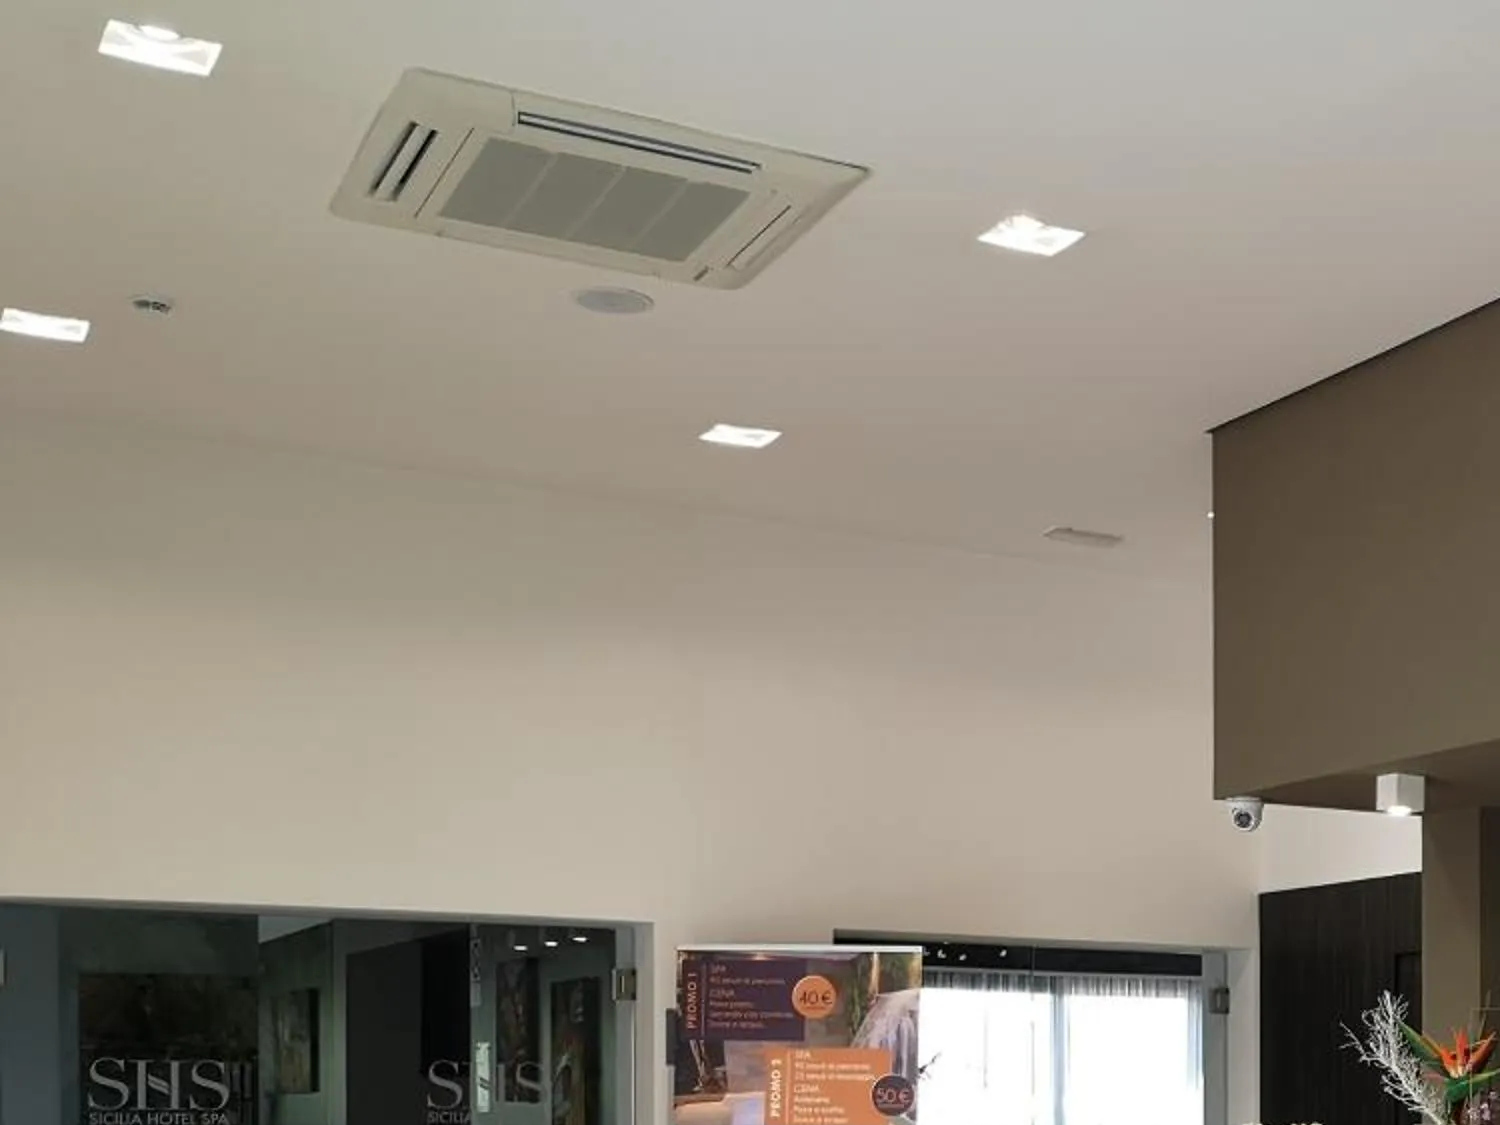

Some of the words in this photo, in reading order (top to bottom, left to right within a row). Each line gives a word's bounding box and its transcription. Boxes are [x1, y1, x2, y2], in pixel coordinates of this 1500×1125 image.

[687, 981, 698, 1029] PROMO
[87, 1057, 230, 1111] SHS
[770, 1069, 782, 1118] PROMO
[147, 1112, 197, 1125] HOTEL
